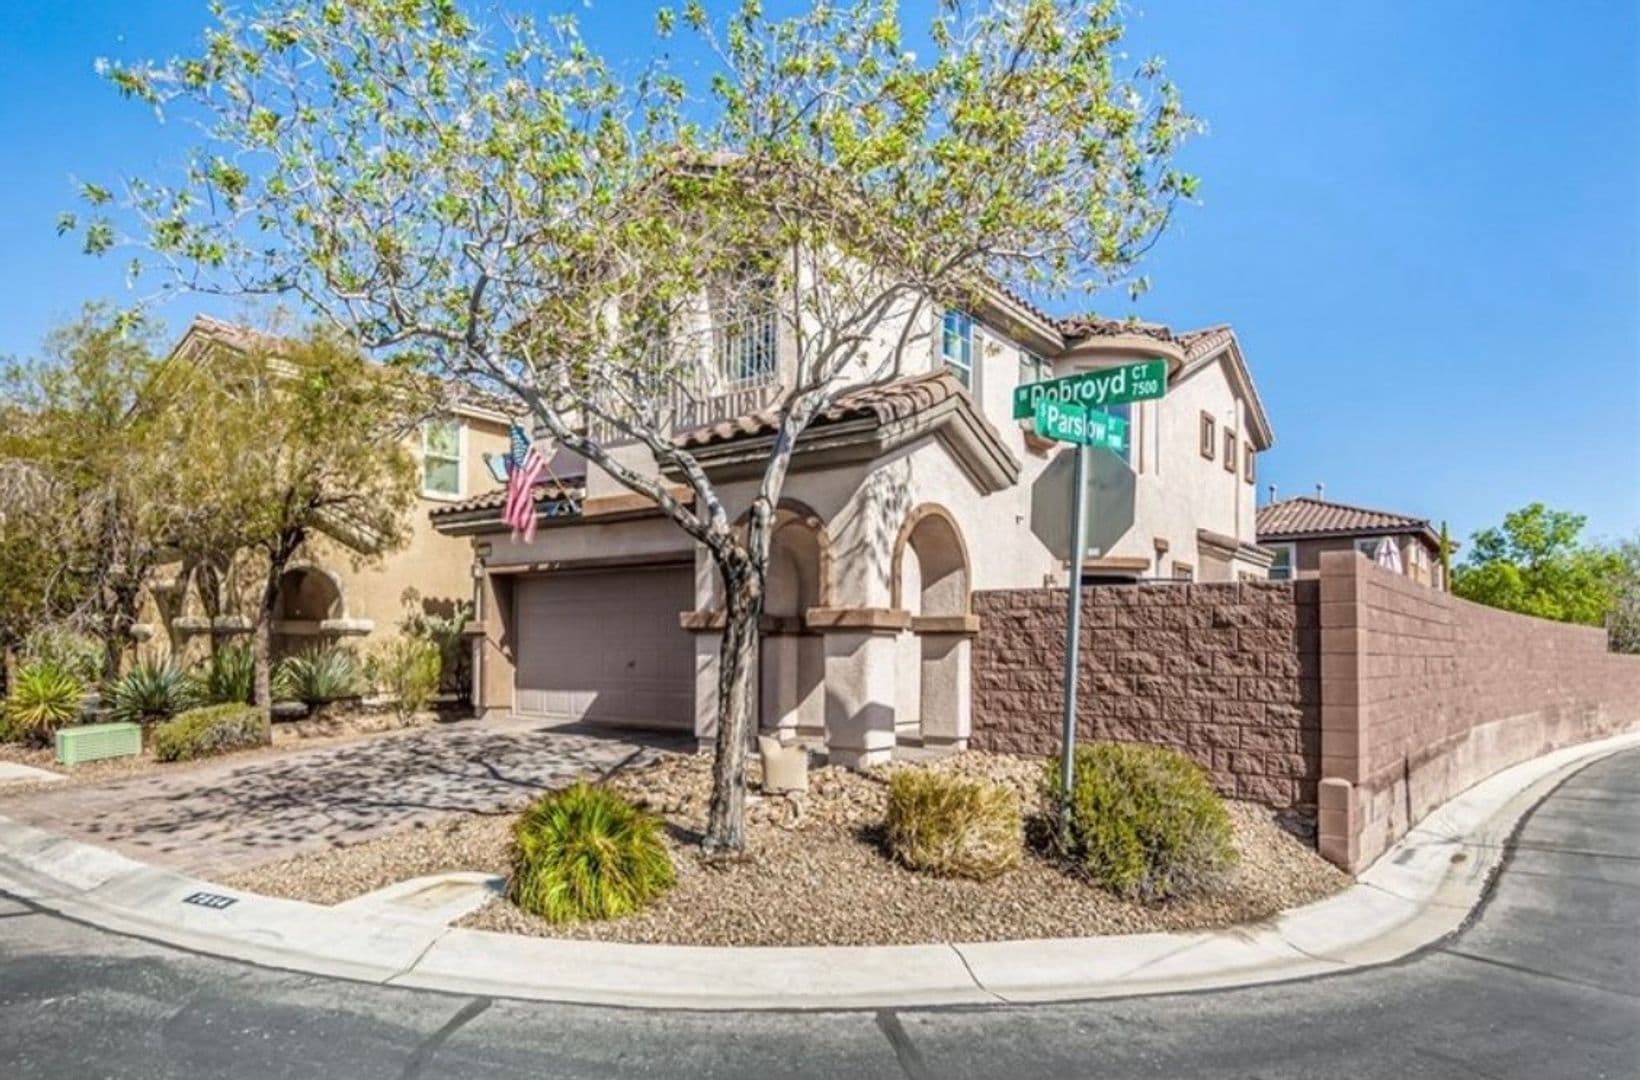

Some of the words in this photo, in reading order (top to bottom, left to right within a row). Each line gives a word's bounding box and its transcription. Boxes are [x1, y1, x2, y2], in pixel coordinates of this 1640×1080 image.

[1031, 367, 1126, 409] Dobroyd
[1131, 364, 1150, 380] CT
[1132, 379, 1159, 395] 7500
[1047, 405, 1106, 441] Parslow
